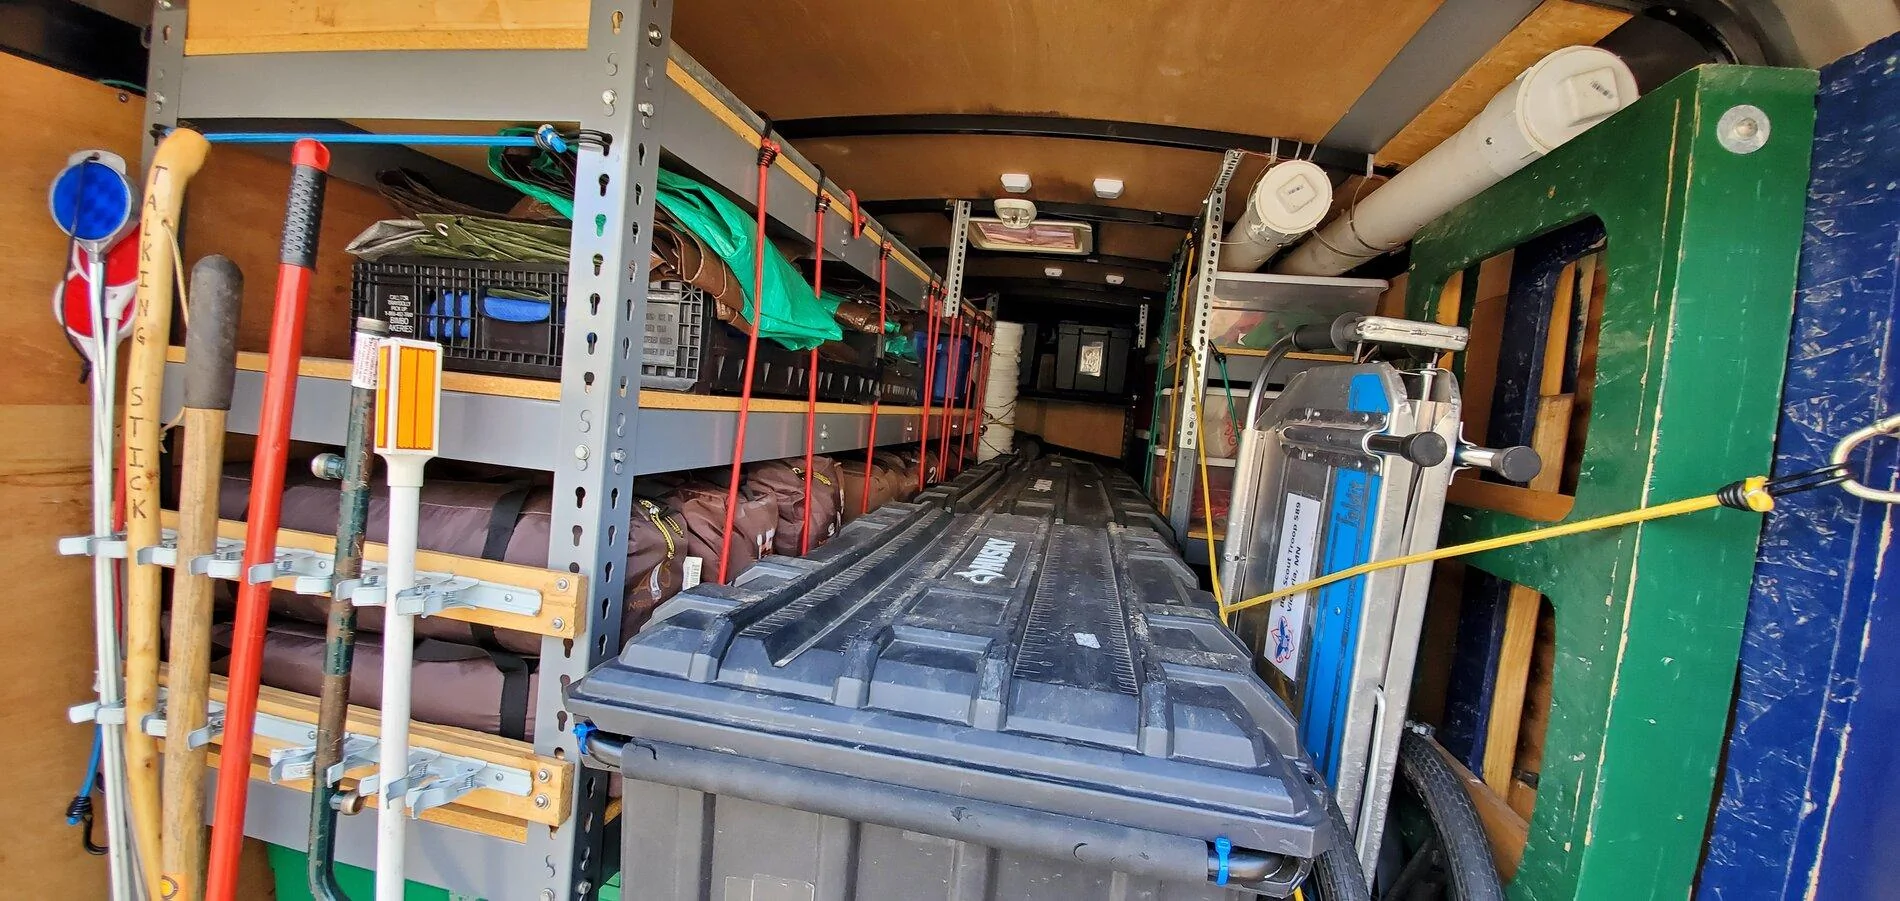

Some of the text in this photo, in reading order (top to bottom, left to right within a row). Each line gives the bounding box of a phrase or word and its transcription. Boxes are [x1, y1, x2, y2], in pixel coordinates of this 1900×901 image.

[390, 316, 409, 325] BIMBO
[129, 165, 168, 520] TALKING STICK
[1283, 557, 1292, 586] Scout
[1288, 524, 1298, 554] Troop
[1295, 546, 1302, 566] MN
